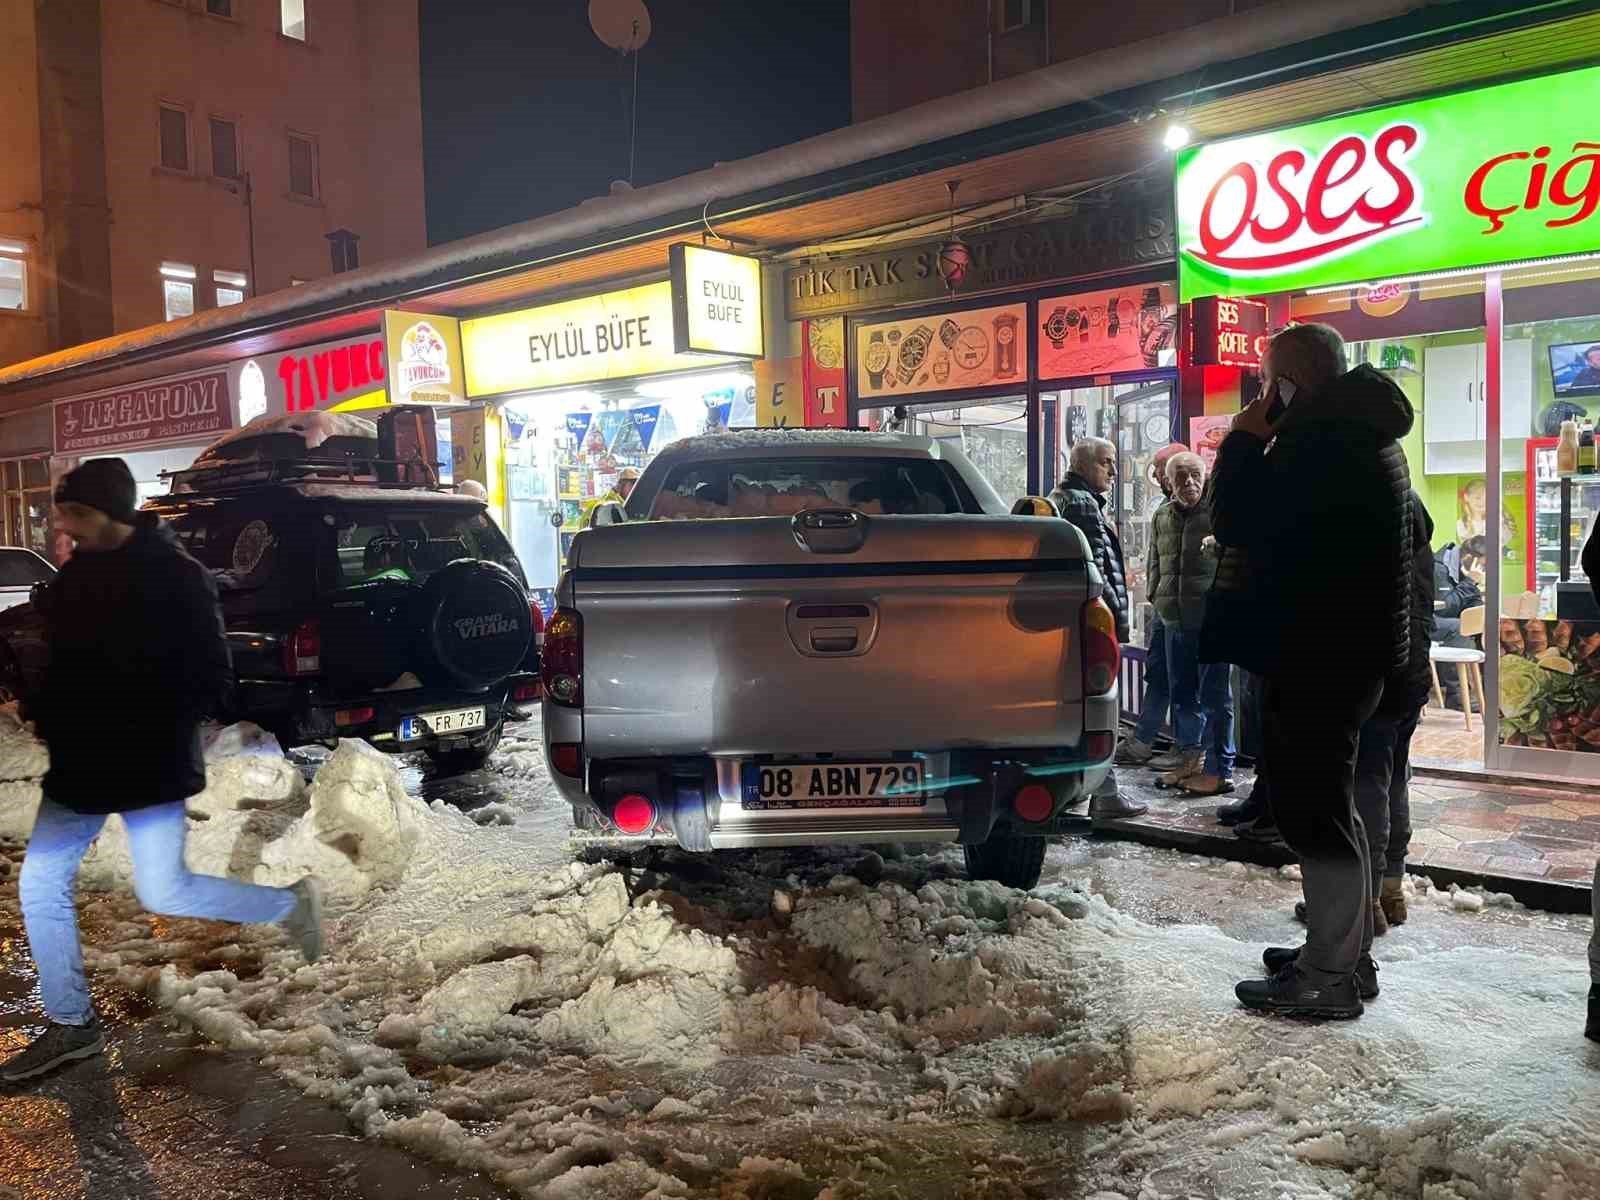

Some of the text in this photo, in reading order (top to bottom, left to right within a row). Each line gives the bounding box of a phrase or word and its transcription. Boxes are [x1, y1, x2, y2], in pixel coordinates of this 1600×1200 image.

[792, 268, 835, 298] TİK
[847, 258, 904, 290] TAK
[916, 244, 996, 283] ST
[528, 313, 652, 363] EYLÜL BÜFE
[81, 378, 219, 432] LEGATOM
[454, 613, 504, 628] GRAND
[458, 618, 519, 640] VITARA
[434, 715, 452, 731] FR
[458, 710, 482, 727] 737
[760, 768, 793, 798] 08
[808, 766, 861, 797] ABN
[865, 765, 918, 797] 729
